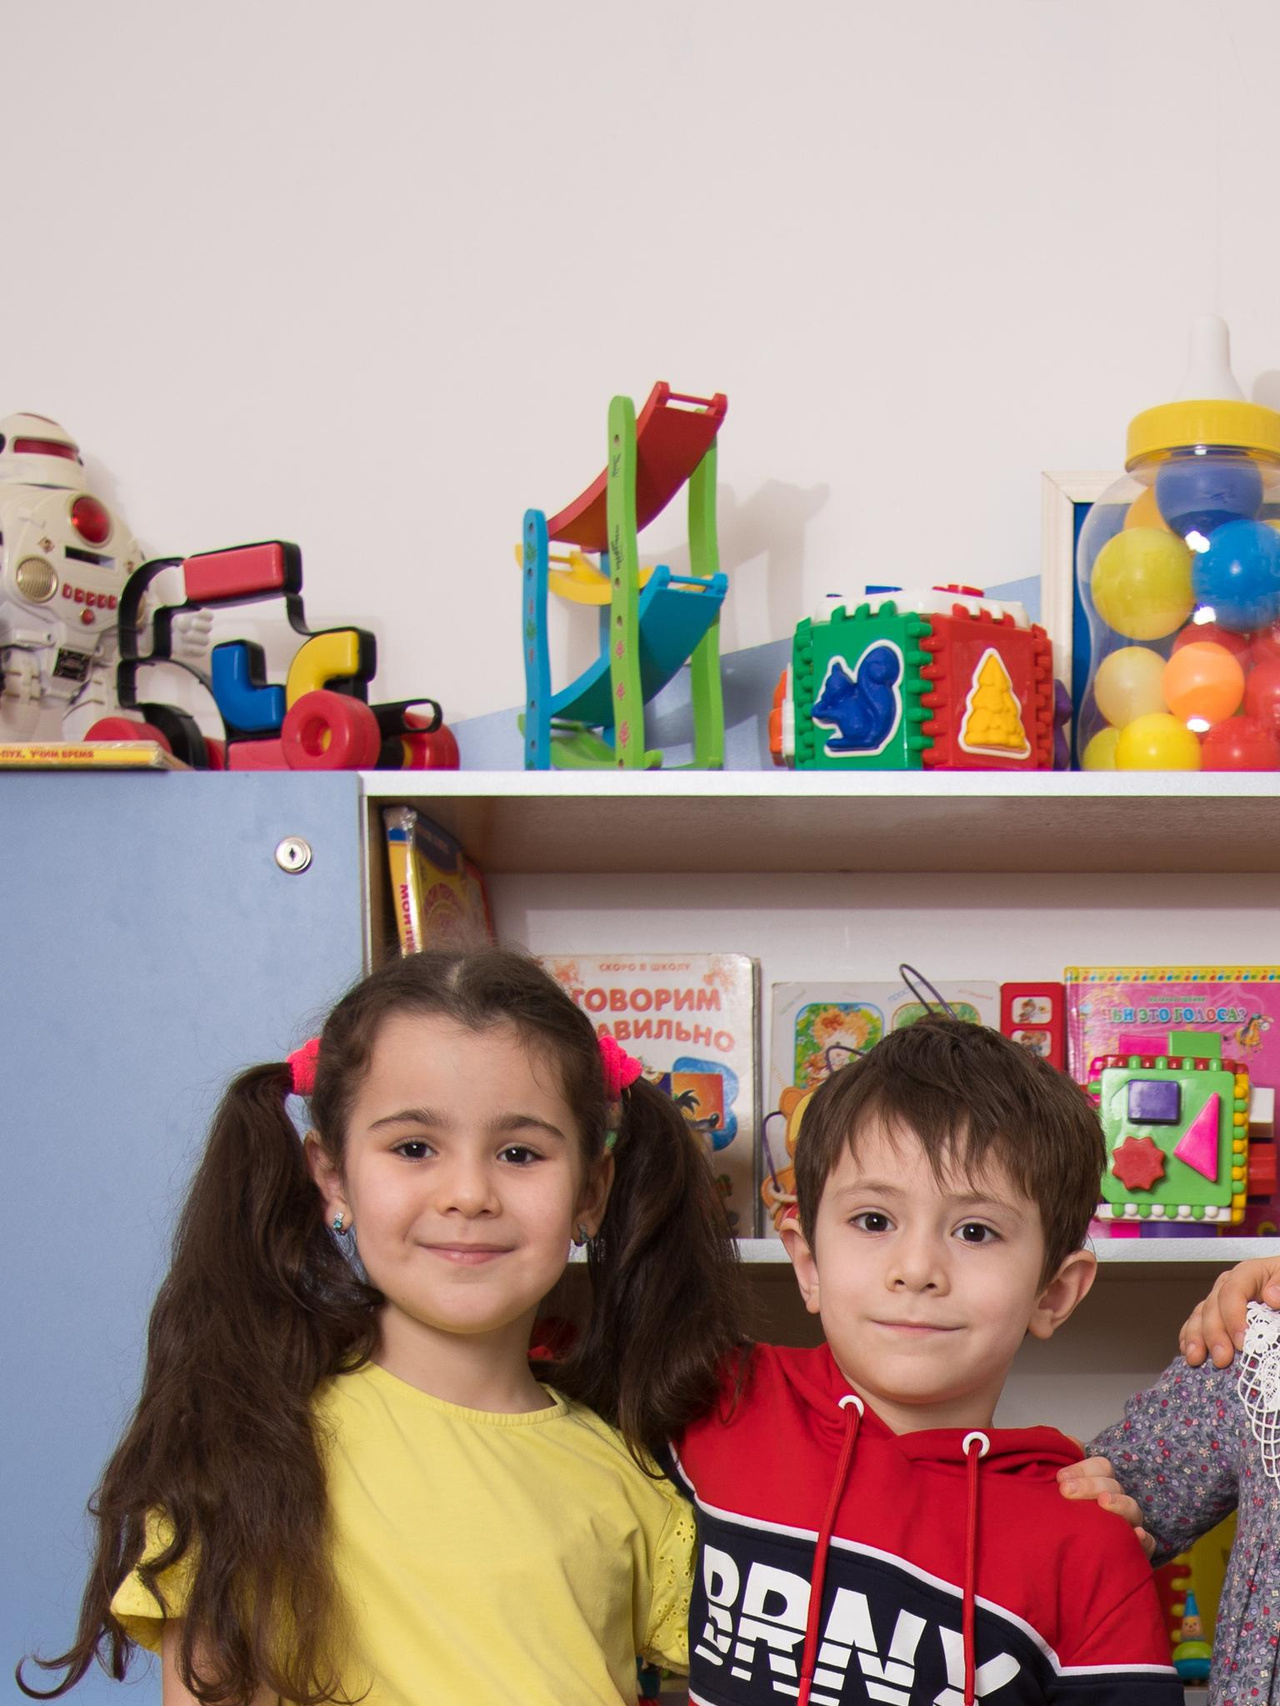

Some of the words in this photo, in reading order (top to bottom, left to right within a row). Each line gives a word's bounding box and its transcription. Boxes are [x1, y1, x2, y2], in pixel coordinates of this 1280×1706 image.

[599, 963, 636, 972] СКОРО
[650, 963, 691, 972] ШКОЛУ
[571, 988, 721, 1012] ГОВОРИМ
[1138, 1007, 1171, 1023] ЭТО
[1173, 1007, 1247, 1023] ГОЛОСА?
[598, 1019, 735, 1052] АВИЛЬНО
